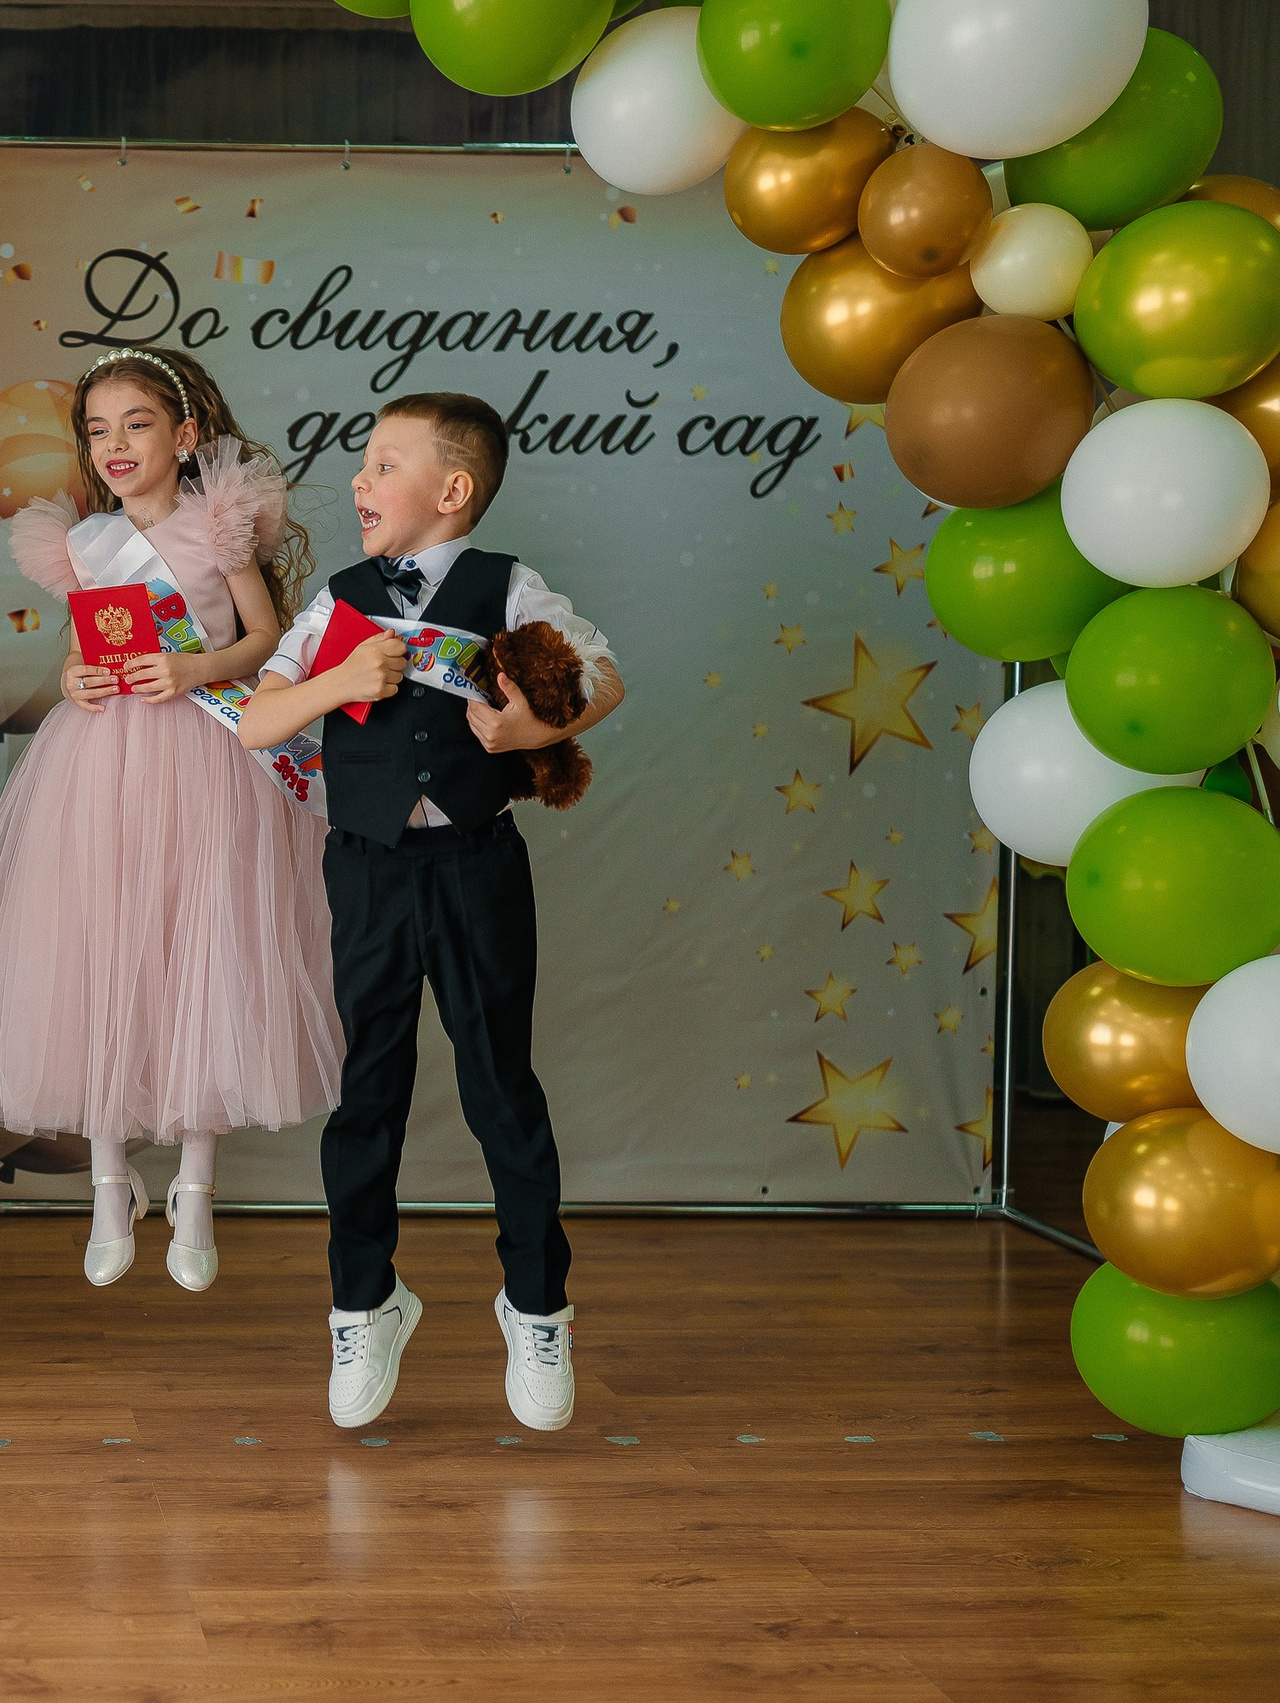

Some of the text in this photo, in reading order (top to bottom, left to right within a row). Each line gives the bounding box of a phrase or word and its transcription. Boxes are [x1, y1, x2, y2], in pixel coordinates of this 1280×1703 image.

[59, 248, 680, 393] До свидания,
[281, 369, 823, 500] декий сад
[99, 650, 148, 665] ДИПЛО
